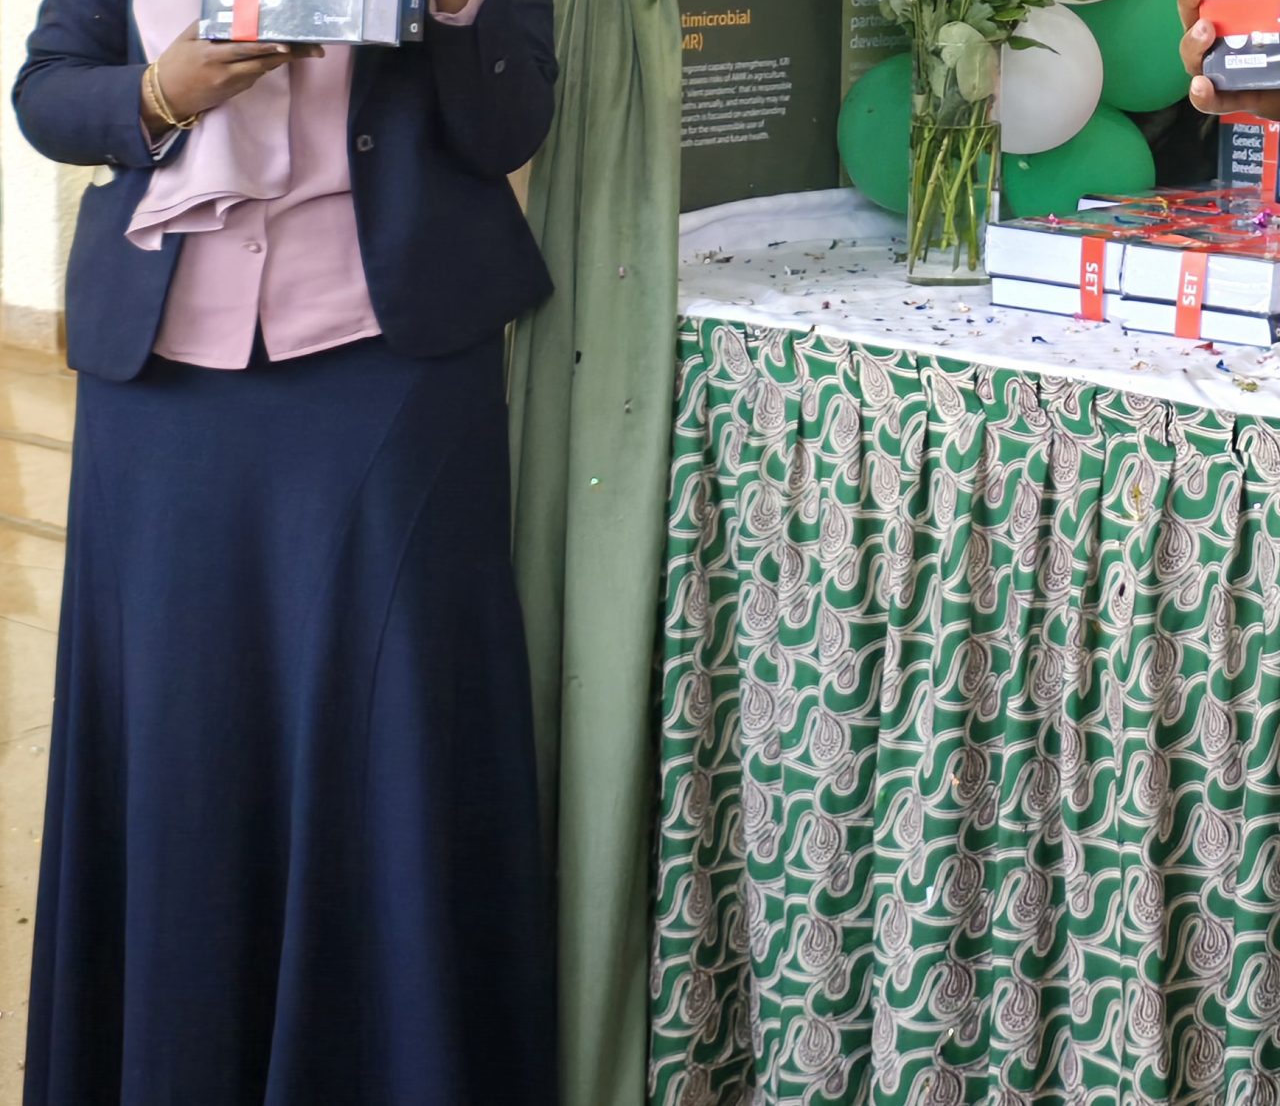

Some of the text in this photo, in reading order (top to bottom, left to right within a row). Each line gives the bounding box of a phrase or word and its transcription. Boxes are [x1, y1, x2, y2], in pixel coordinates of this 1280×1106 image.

[682, 9, 750, 28] timicrobial
[1232, 134, 1262, 148] Genetic
[1232, 148, 1248, 160] and
[1086, 261, 1099, 295] SET
[1182, 271, 1199, 306] SET
